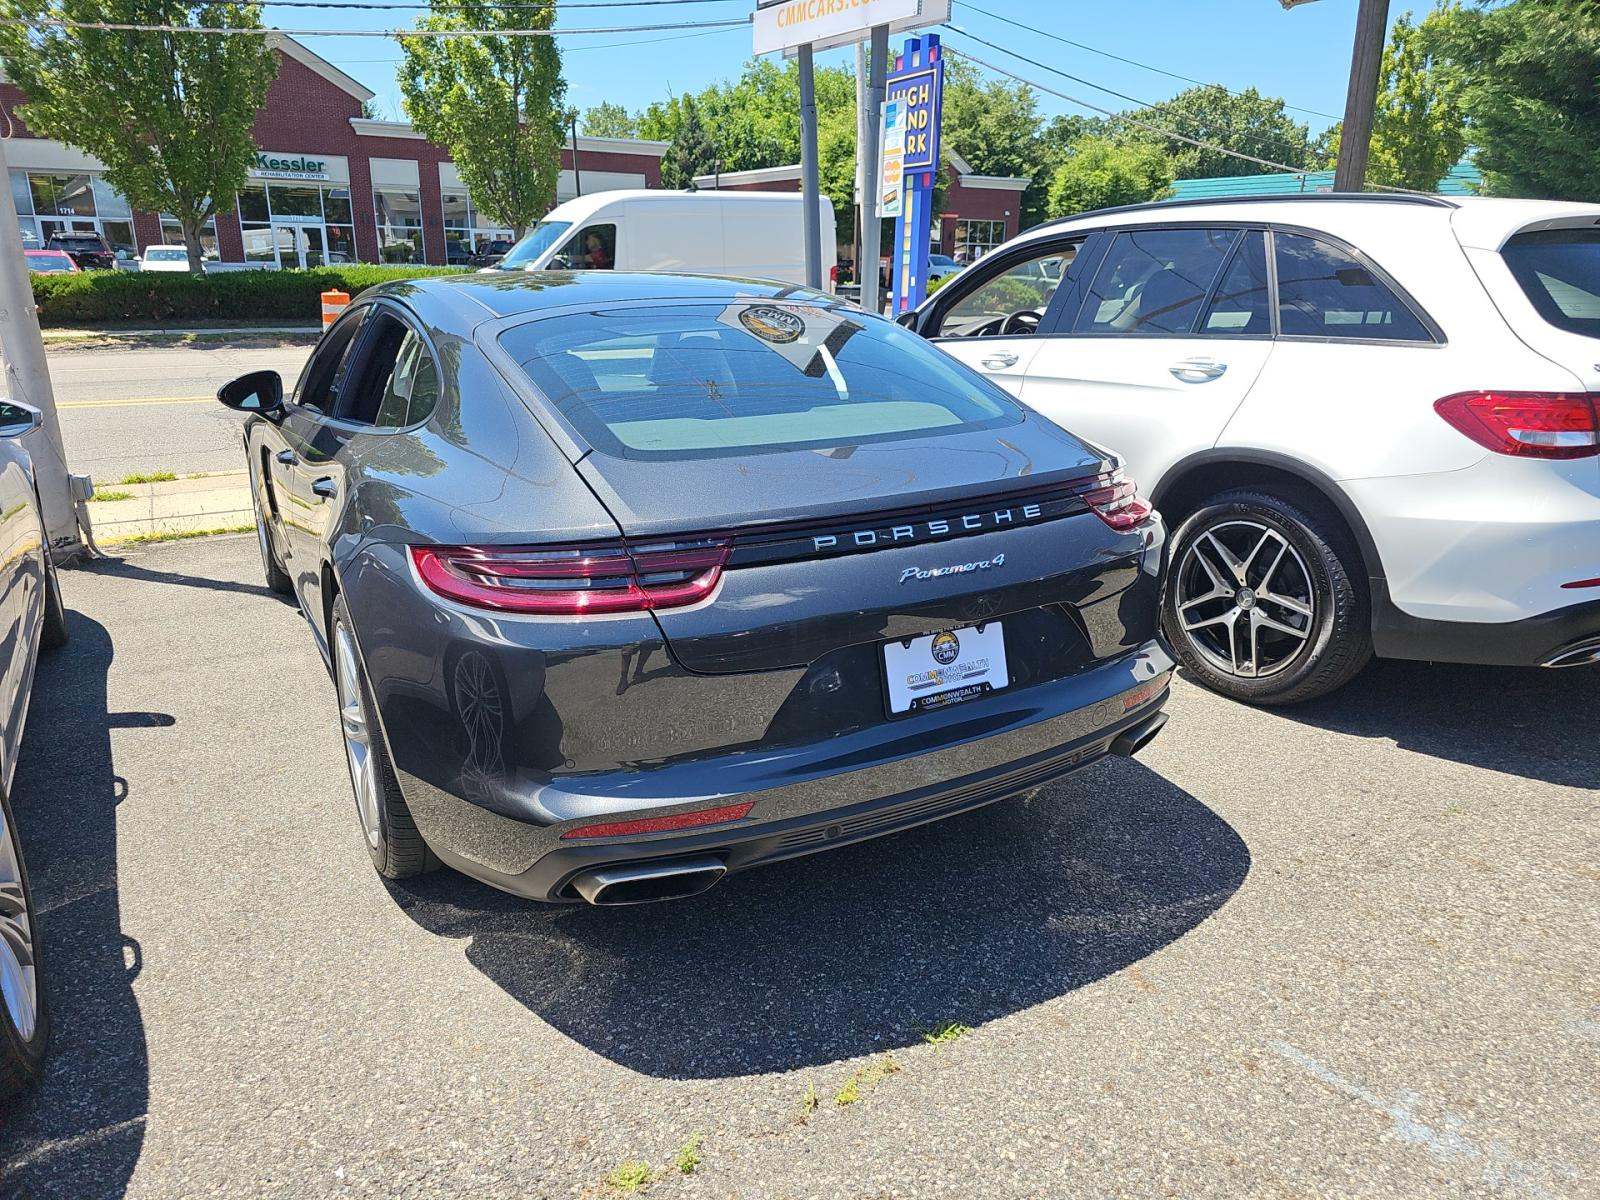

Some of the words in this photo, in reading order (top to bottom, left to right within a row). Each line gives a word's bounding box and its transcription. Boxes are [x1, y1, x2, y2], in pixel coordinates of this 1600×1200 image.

[256, 154, 325, 172] Kessler
[814, 504, 1042, 551] PORSCHE
[900, 558, 991, 583] Panamera
[992, 553, 1005, 566] 4
[938, 649, 955, 661] CMM
[921, 685, 981, 705] COMMONWEALTH
